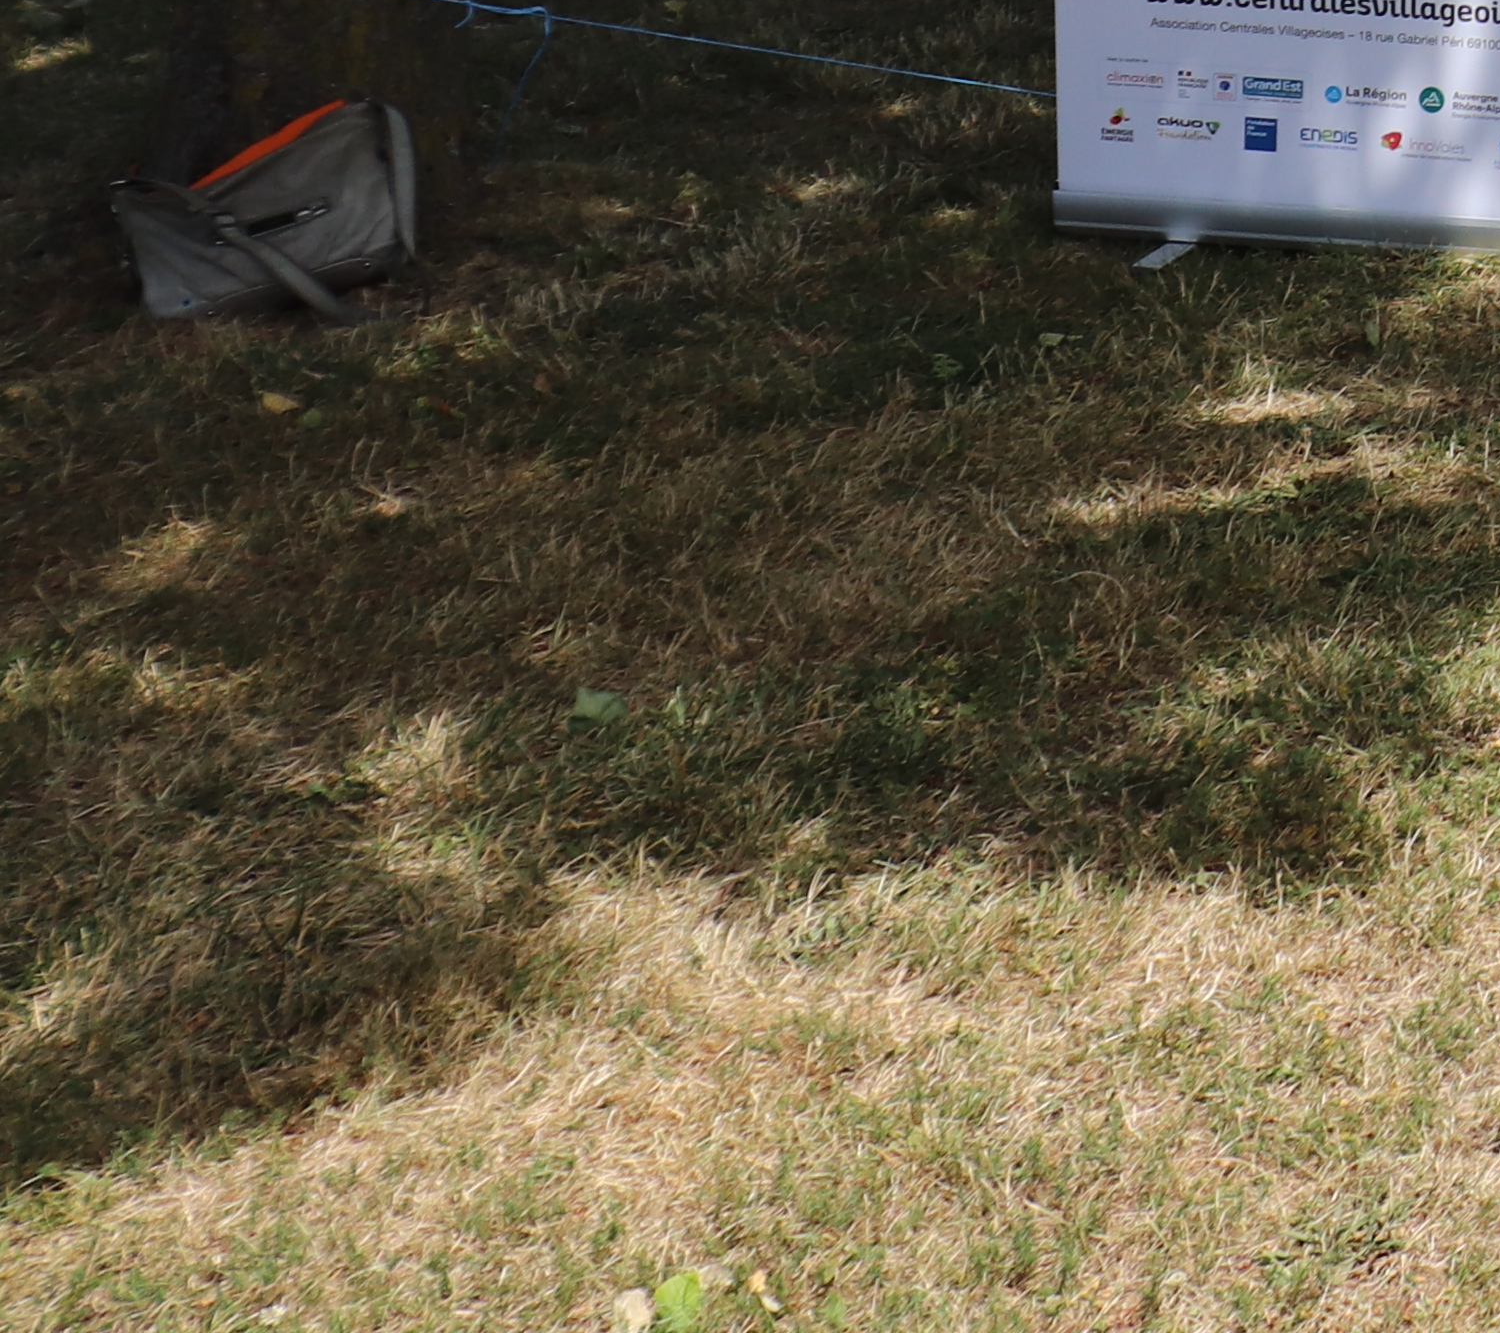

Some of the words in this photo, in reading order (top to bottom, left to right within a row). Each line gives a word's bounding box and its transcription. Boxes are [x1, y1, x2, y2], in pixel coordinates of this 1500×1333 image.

[1151, 17, 1216, 32] Association
[1220, 21, 1274, 35] Centrales
[1278, 25, 1344, 40] Villageoises
[1359, 31, 1372, 42] 18
[1376, 33, 1393, 43] rue
[1397, 33, 1438, 46] Gabriel
[1442, 36, 1464, 47] Péri
[1244, 78, 1281, 91] Grand
[1283, 81, 1302, 93] Est
[1346, 86, 1361, 97] La
[1363, 87, 1407, 101] Région
[1452, 92, 1499, 103] Auvergne
[1158, 116, 1204, 128] akuo
